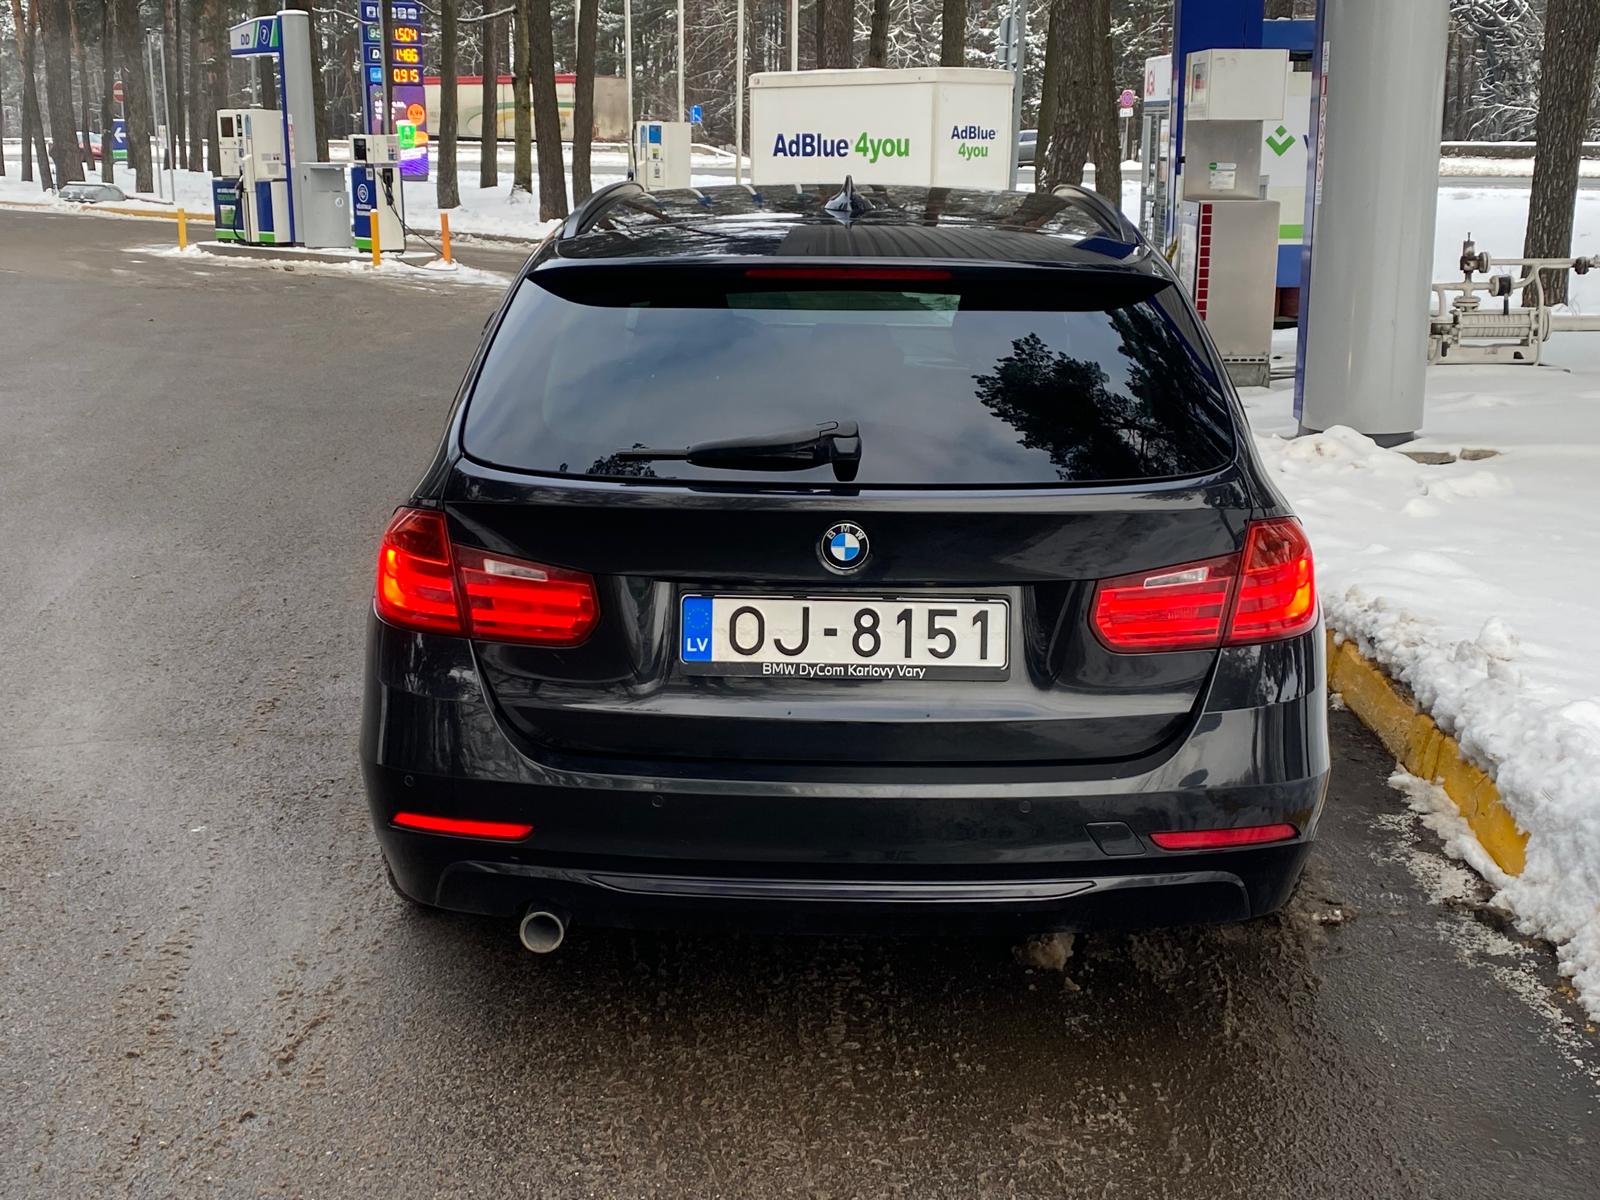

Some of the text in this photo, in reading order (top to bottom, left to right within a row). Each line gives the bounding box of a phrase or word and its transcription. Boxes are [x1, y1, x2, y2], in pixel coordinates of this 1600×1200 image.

[951, 125, 996, 140] AdBlue
[773, 131, 910, 163] AdBlue 4you
[958, 142, 988, 161] 4you
[826, 524, 865, 540] BMW
[728, 605, 989, 661] OJ-8151
[686, 638, 708, 652] LV
[762, 662, 926, 679] BMW DyCom Karlovy Vary
